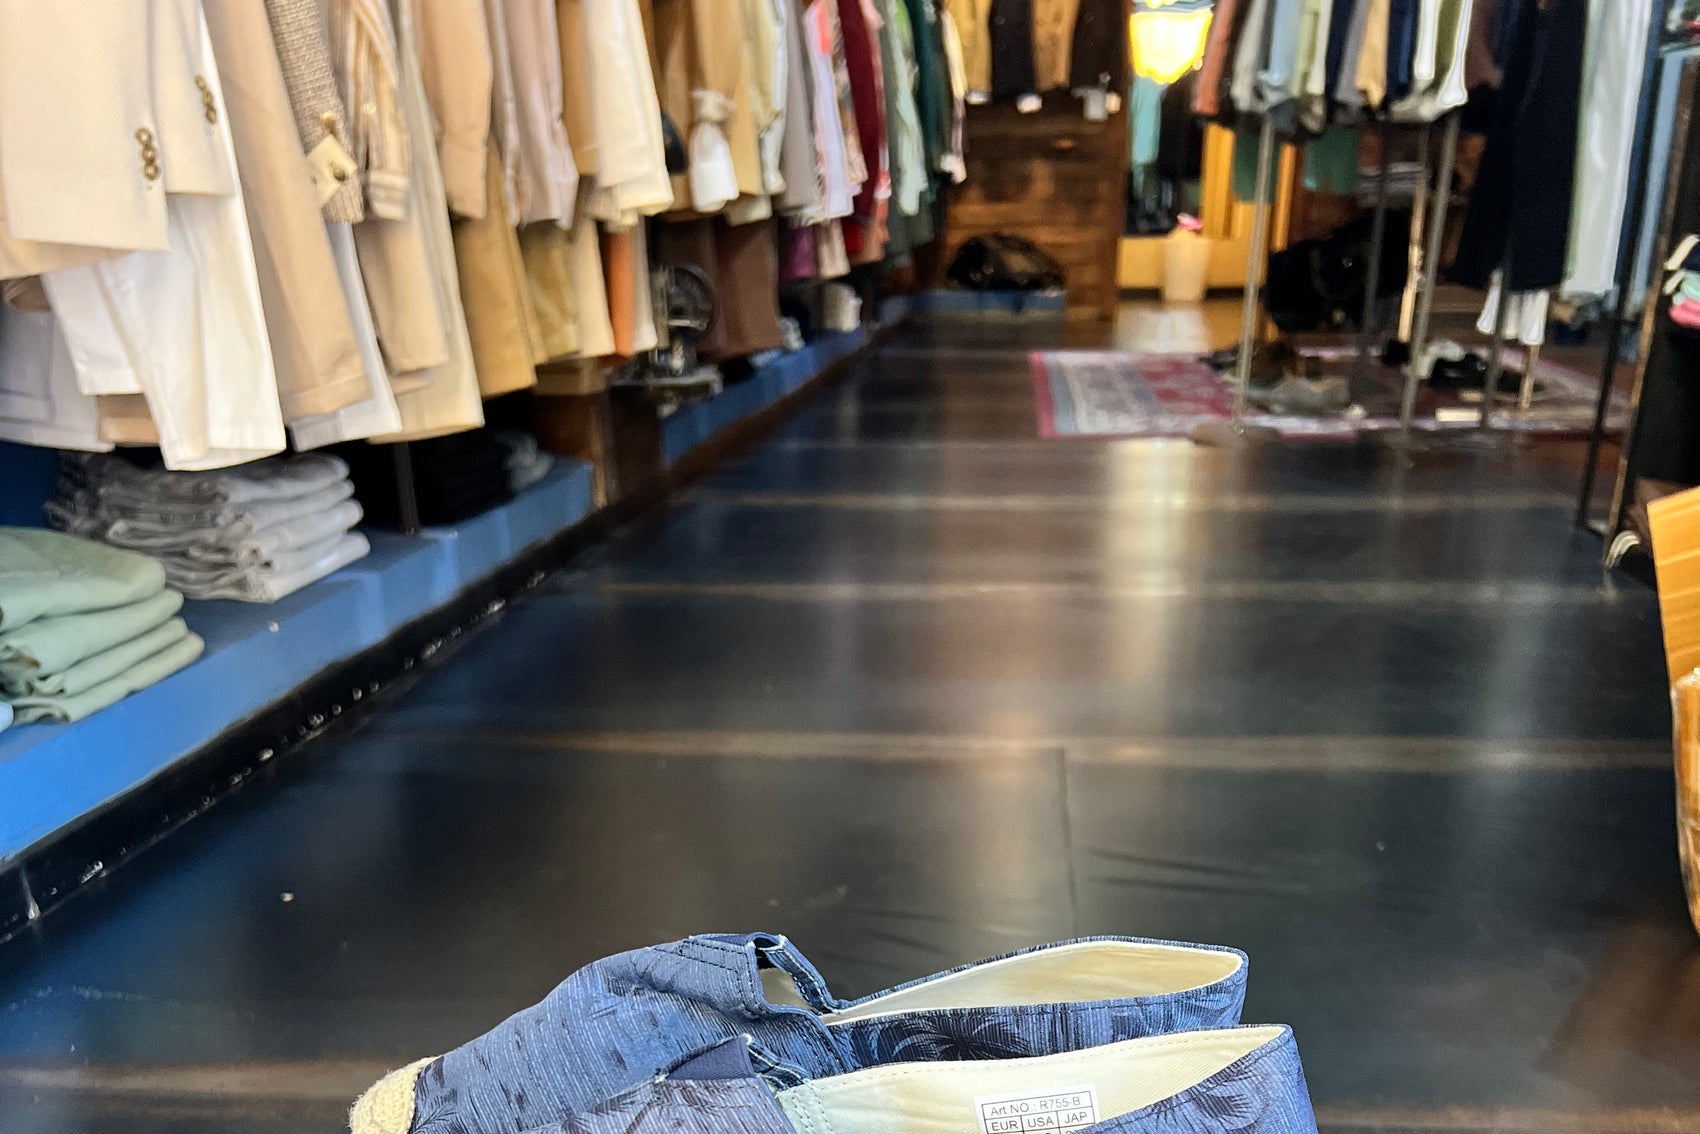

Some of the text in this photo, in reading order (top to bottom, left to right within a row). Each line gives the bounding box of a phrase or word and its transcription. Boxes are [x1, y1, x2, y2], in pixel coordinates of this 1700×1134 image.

[991, 1106, 1007, 1116] Art
[1040, 1096, 1080, 1109] R755-B
[991, 1111, 1088, 1131] EUR USA JAP
